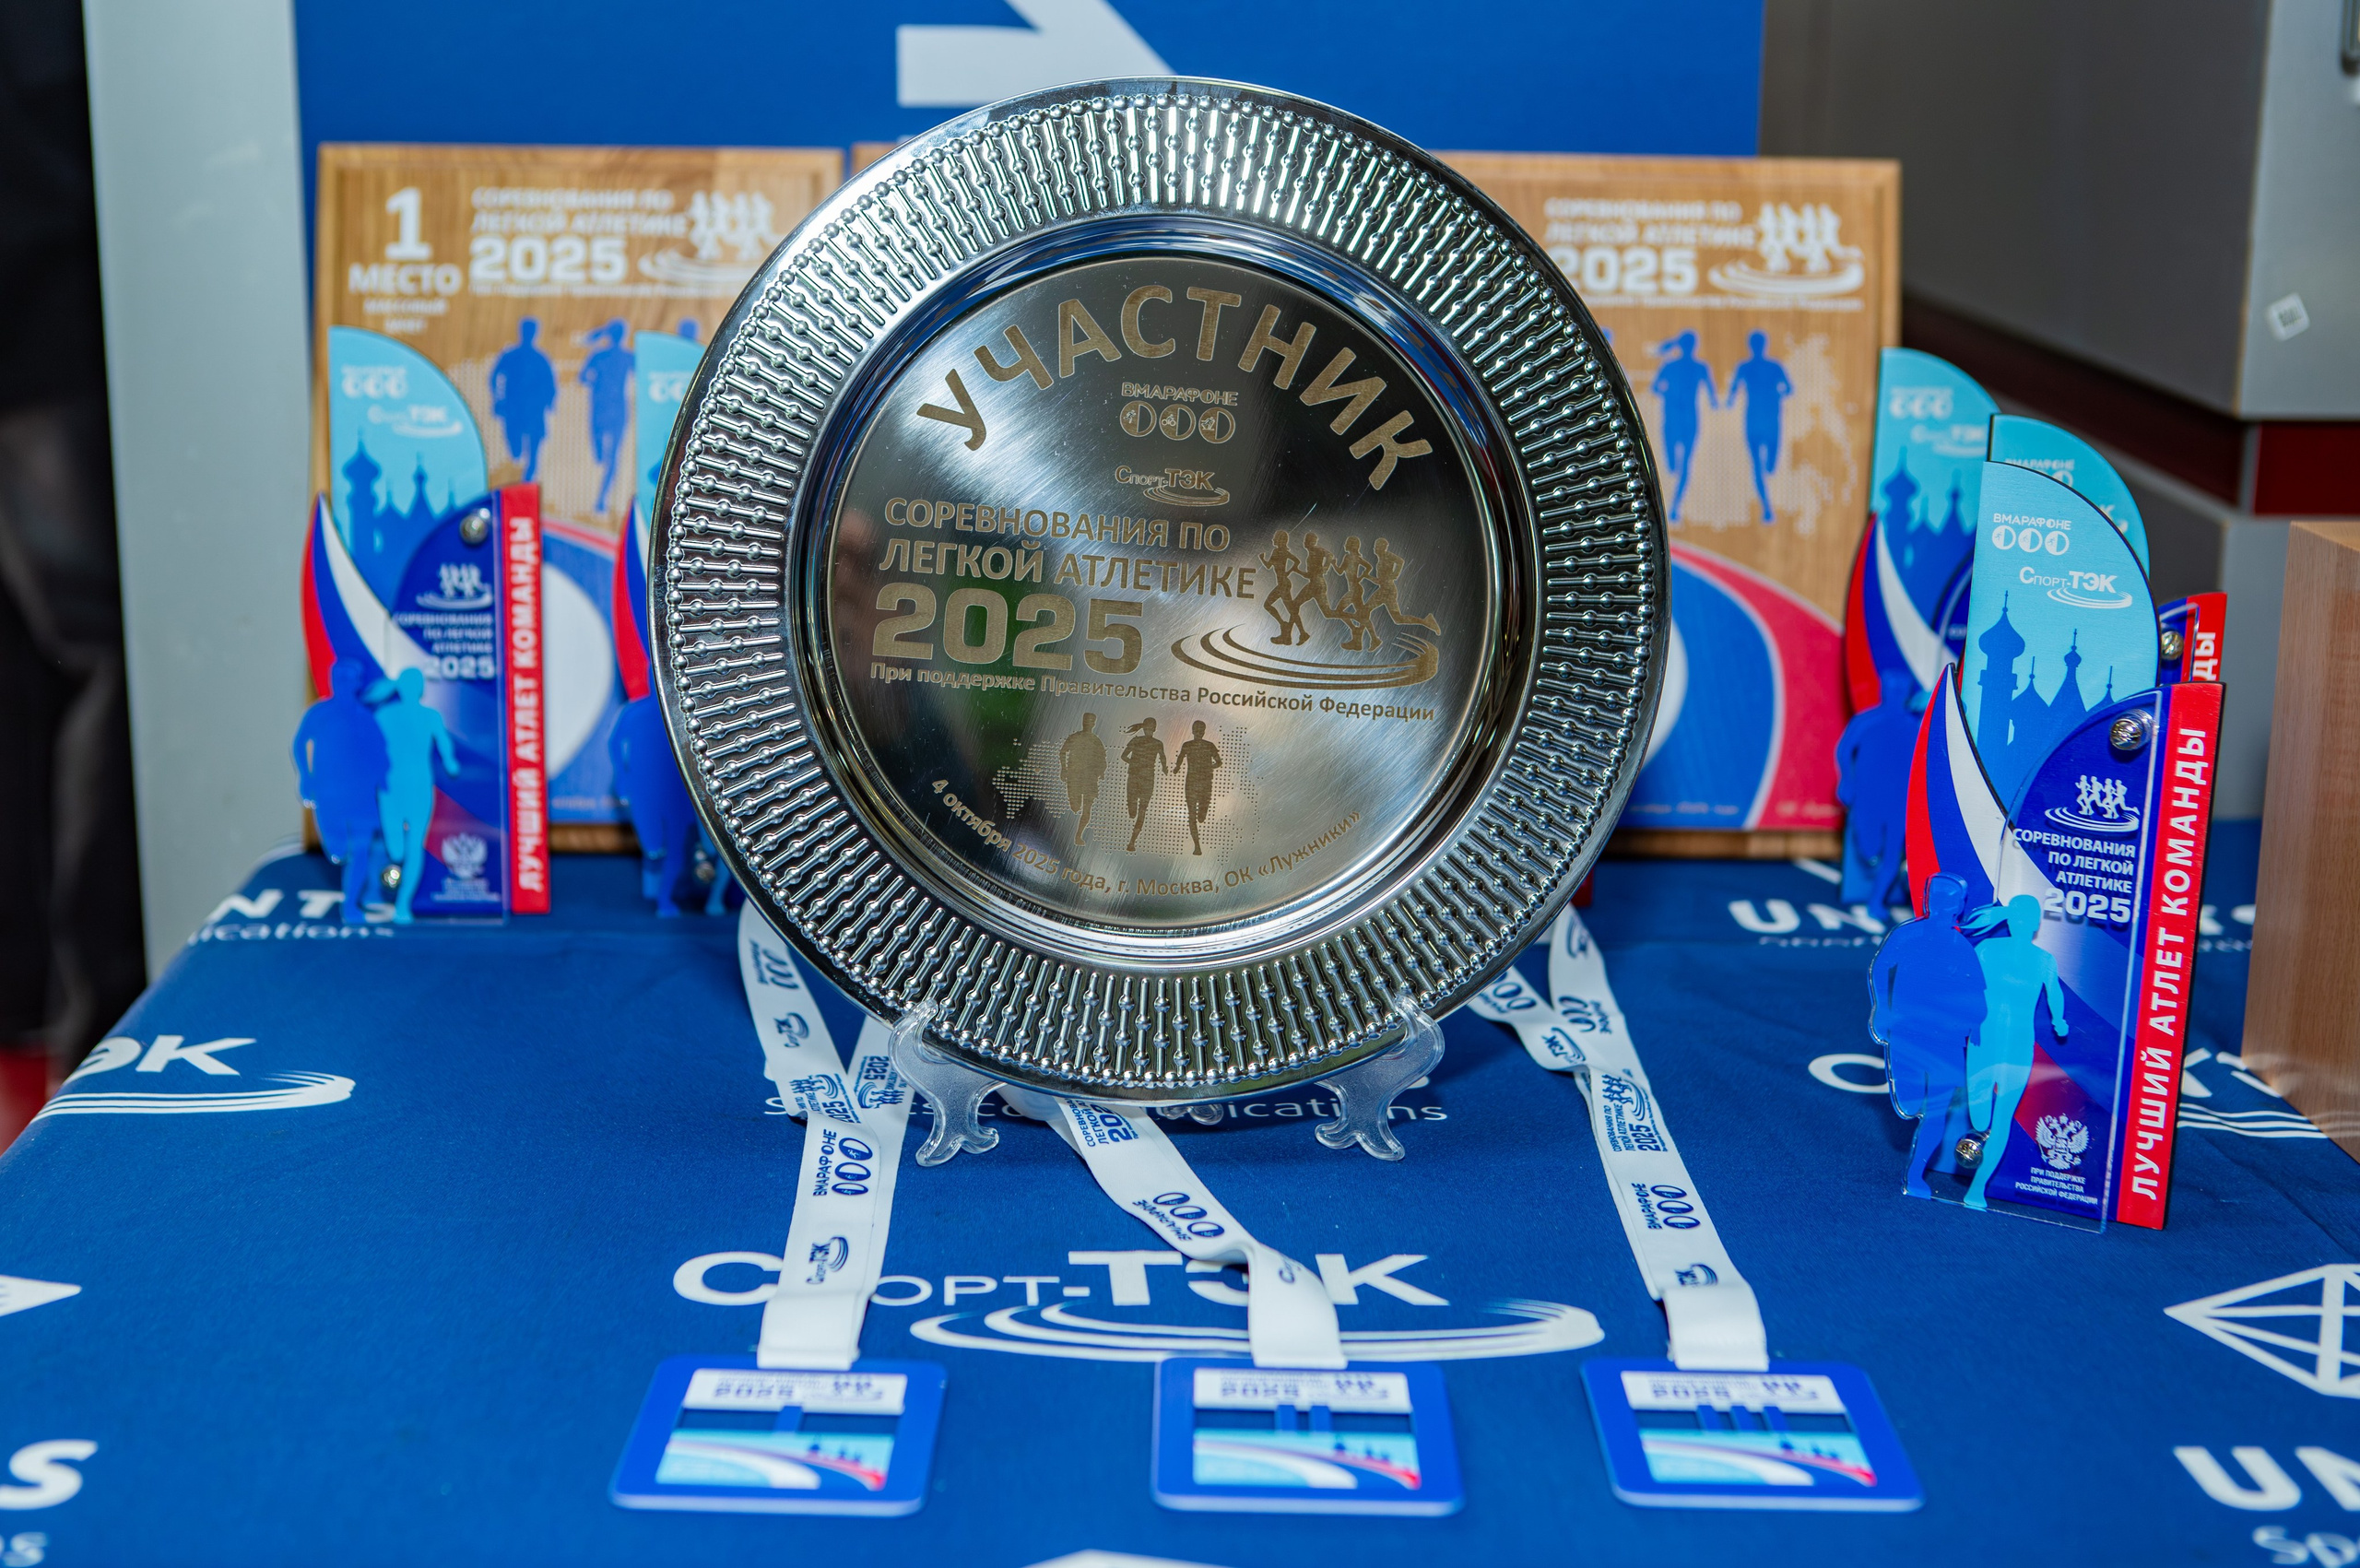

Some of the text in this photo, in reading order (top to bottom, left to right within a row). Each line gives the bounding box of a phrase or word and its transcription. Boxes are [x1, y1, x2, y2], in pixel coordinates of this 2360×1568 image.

[385, 187, 431, 262] 1
[348, 262, 461, 295] МЕСТО
[468, 235, 628, 282] 2025
[916, 285, 1434, 490] УЧАСТНИК
[1121, 382, 1239, 407] ВМАРАФОНЕ
[885, 497, 1231, 552] СОРЕВНОВАНИЯ ПО
[1993, 513, 2072, 531] ВМАРАФОНЕ
[879, 537, 1257, 600] ЛЕГКОЙ АТЛЕТИКЕ
[872, 582, 1143, 675] 2025
[510, 516, 544, 892] ЛУЧШИЙ АТЛЕТ КОМАНДЫ
[870, 662, 1434, 722] При поддержке Правительства Российской Федерации
[931, 779, 1362, 896] 4 октября 2025 года, г. Москва, ОК «Лужники»
[2012, 829, 2136, 858] СОРЕВНОВАНИЯ
[2047, 851, 2134, 876] ПО ЛЕГКОЙ
[2044, 887, 2131, 924] 2025
[2055, 870, 2132, 894] АТЛЕТИКЕ
[2131, 728, 2209, 1200] ЛУЧШИЙ АТЛЕТ КОМАНДЫ
[812, 1128, 837, 1197] ВМАРАФОНЕ
[1628, 1123, 1662, 1152] 2025
